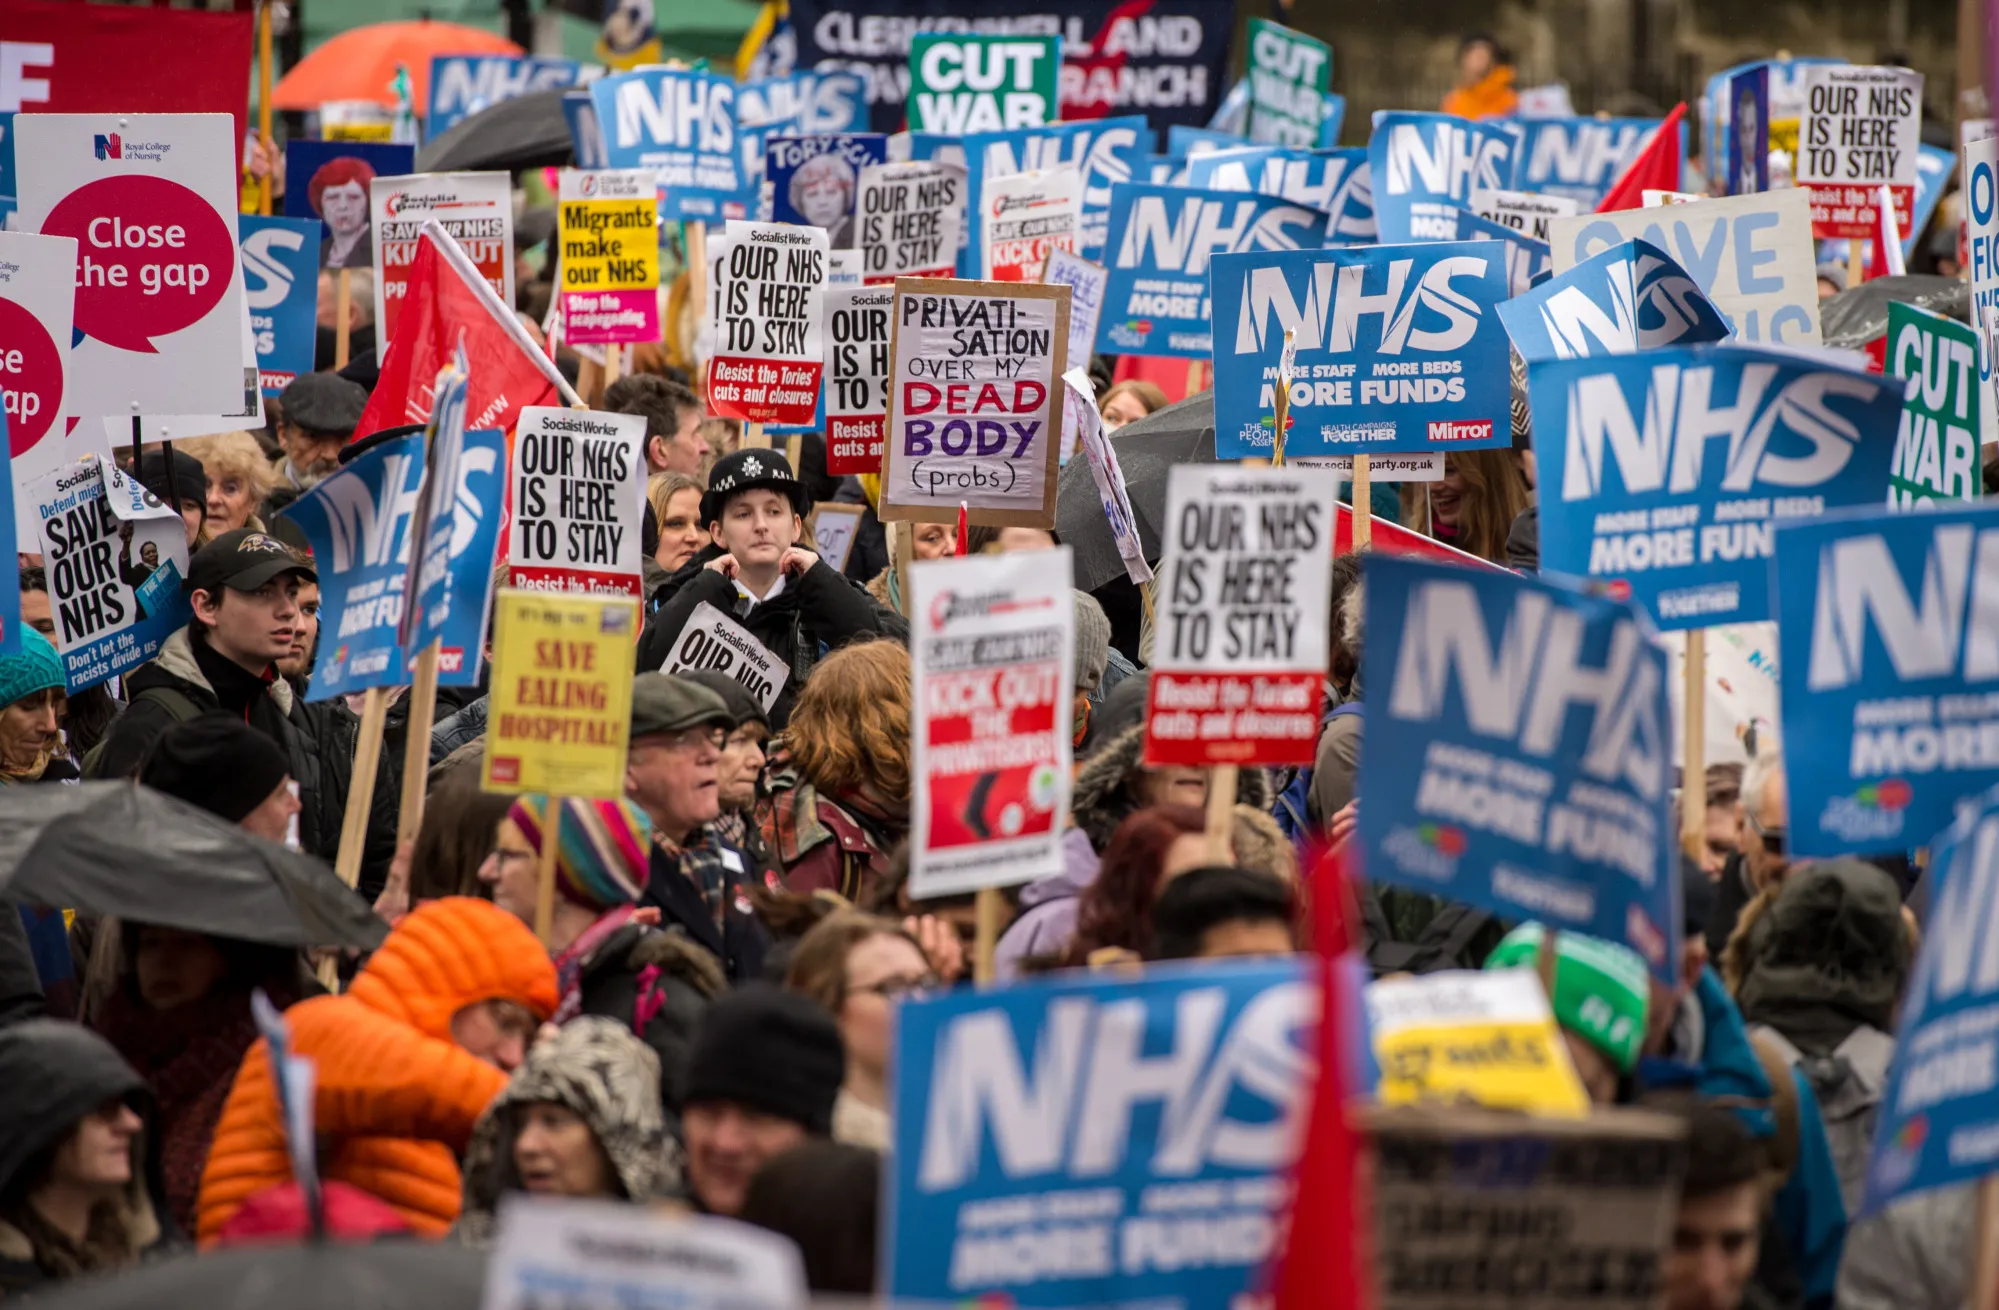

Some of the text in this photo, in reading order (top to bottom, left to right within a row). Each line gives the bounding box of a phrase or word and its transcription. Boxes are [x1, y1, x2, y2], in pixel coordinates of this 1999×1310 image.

[1103, 15, 1203, 58] AND
[921, 42, 1046, 92] CUT
[1252, 29, 1327, 86] CUT
[1061, 64, 1207, 107] RANCH
[1250, 66, 1324, 121] WAR
[1810, 85, 1913, 117] OUR NHS
[615, 76, 735, 154] NHS
[916, 92, 1046, 135] WAR
[125, 142, 171, 153] Royal College
[1808, 116, 1898, 147] IS HERE
[125, 152, 161, 163] of Nursing
[767, 135, 833, 169] TORY
[1386, 123, 1509, 201] NHS
[1808, 148, 1901, 179] TO STAY
[396, 202, 436, 214] Party
[401, 193, 457, 203] Socialist
[866, 178, 957, 214] OUR NHS
[1209, 156, 1378, 238] NHS
[1845, 188, 1866, 205] the
[464, 218, 503, 236] NHS
[564, 205, 654, 235] Migrants
[862, 210, 942, 243] IS HERE
[1809, 206, 1856, 223] uts and
[88, 217, 186, 249] Close
[566, 236, 623, 259] make
[751, 230, 812, 245] Socialist Worker
[1116, 196, 1315, 276] NHS
[730, 244, 823, 285] OUR NHS
[863, 237, 943, 271] TO STAY
[991, 243, 1034, 267] KICK
[139, 263, 210, 296] gap
[567, 259, 648, 285] our NHS
[829, 271, 858, 283] orkers
[569, 294, 621, 315] Stop the
[726, 280, 812, 320] IS HERE
[851, 295, 895, 306] Socialist
[902, 297, 1027, 329] PRIVATI-
[1127, 293, 1199, 320] MORE
[1234, 255, 1488, 355] NHS
[569, 309, 647, 330] scapegoating
[725, 316, 811, 356] TO STAY
[832, 308, 888, 343] OUR
[948, 328, 1050, 358] SATION
[715, 361, 816, 388] Resist the Tories'
[833, 344, 859, 378] IS
[908, 357, 976, 380] OVER
[995, 356, 1027, 379] MY
[1262, 360, 1463, 380] MRE STAFF MORE BEDS
[1894, 322, 1975, 420] CUT
[714, 383, 815, 407] cuts and closures
[833, 378, 870, 411] TO
[903, 380, 1047, 416] DEAD
[1259, 378, 1466, 408] MORE FUNDS
[583, 421, 619, 436] Worker
[833, 420, 878, 439] Resist
[903, 420, 1042, 459] BODY
[1244, 423, 1262, 432] THE
[1320, 421, 1397, 432] HEALTH CAMPAIGNS
[1428, 421, 1492, 441] Mirror
[1562, 362, 1881, 502] NHS
[521, 433, 630, 482] OUR NHS
[833, 441, 866, 457] cuts
[1891, 409, 1976, 500] WAR
[56, 466, 102, 492] Socialist
[911, 460, 1017, 497] (probs)
[40, 492, 77, 520] Defend
[519, 477, 618, 523] IS HERE
[46, 497, 118, 560] SAVE
[518, 518, 624, 566] TO STAY
[1180, 501, 1322, 553] OUR NHS
[1588, 529, 1695, 576] MORE
[53, 540, 117, 601] OUR
[515, 572, 564, 592] Resist
[566, 574, 586, 592] the
[1172, 557, 1296, 606] IS HERE
[142, 582, 157, 597] THE
[58, 582, 125, 645] NHS
[68, 631, 135, 671] Don't let the
[680, 628, 734, 672] OUR
[714, 622, 771, 673] Socialist Worker
[1170, 608, 1301, 661] TO STAY
[71, 639, 158, 688] racists divide us
[534, 638, 598, 673] SAVE
[516, 676, 608, 711] EALING
[1414, 772, 1543, 847] MORE
[916, 979, 1326, 1194] NHS
